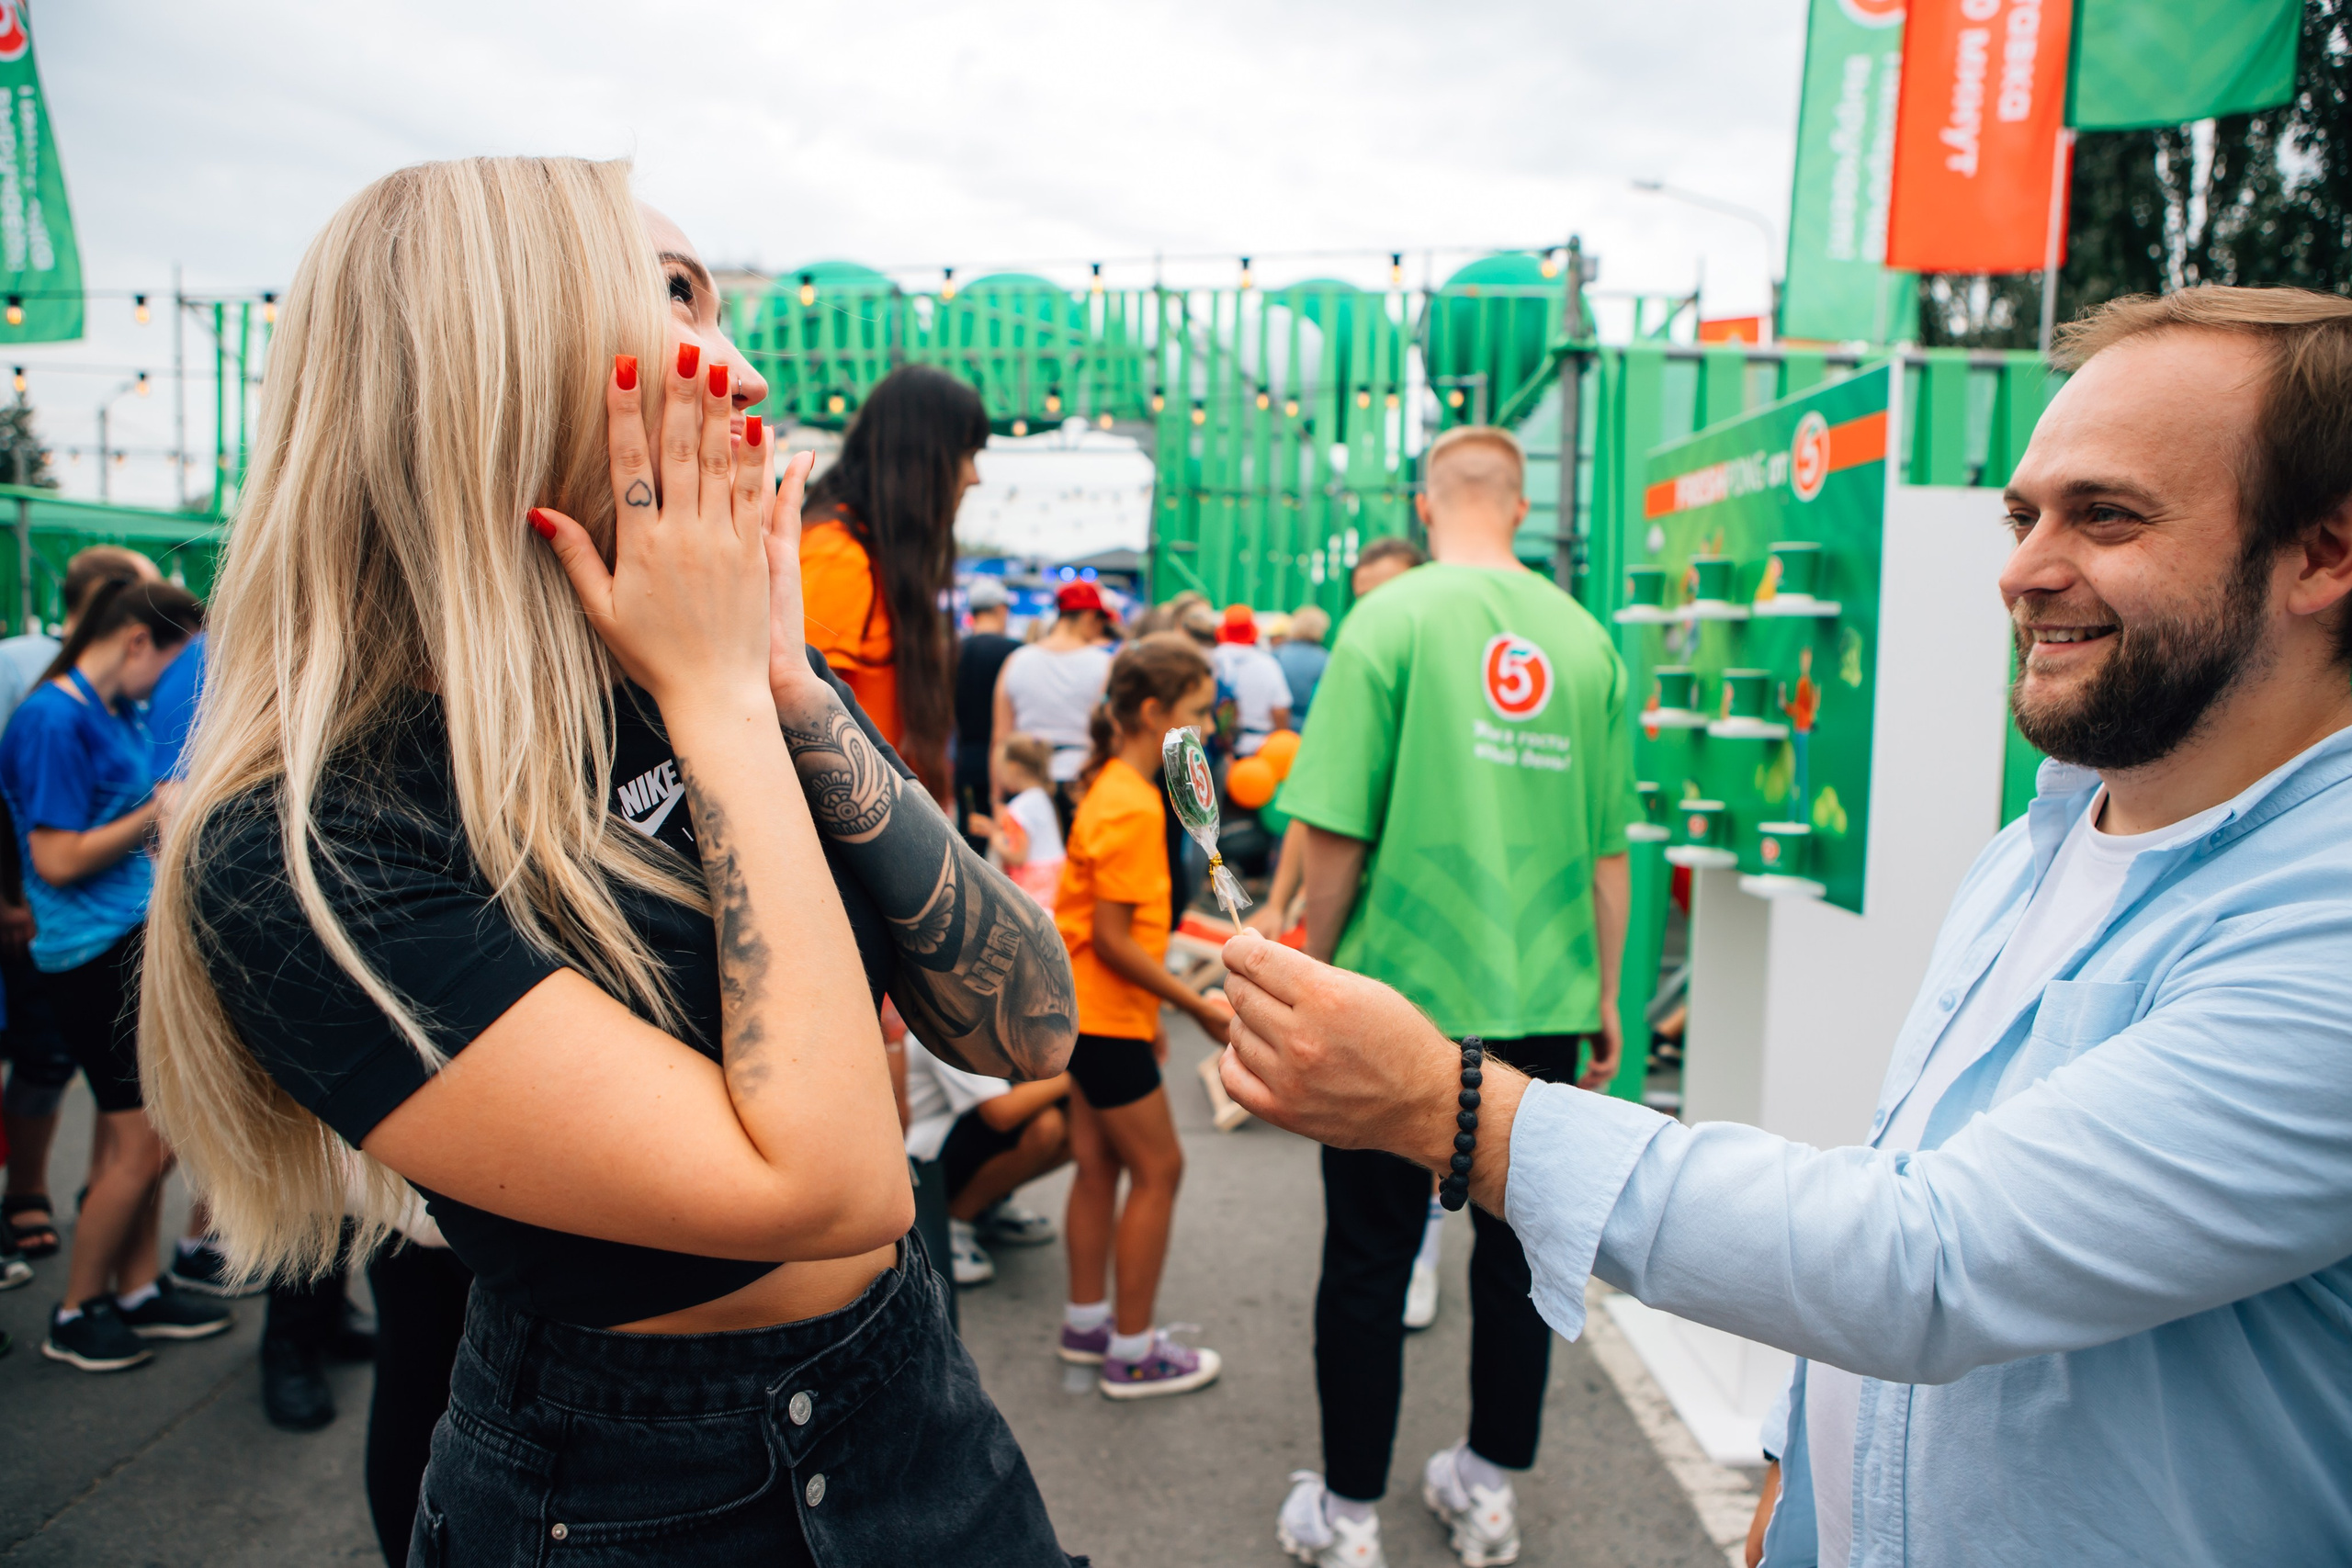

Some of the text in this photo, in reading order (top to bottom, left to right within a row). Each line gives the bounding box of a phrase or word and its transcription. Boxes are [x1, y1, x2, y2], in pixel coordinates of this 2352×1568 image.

[1939, 28, 1991, 178] минут
[1498, 648, 1533, 705] 5
[617, 759, 681, 818] NIKE
